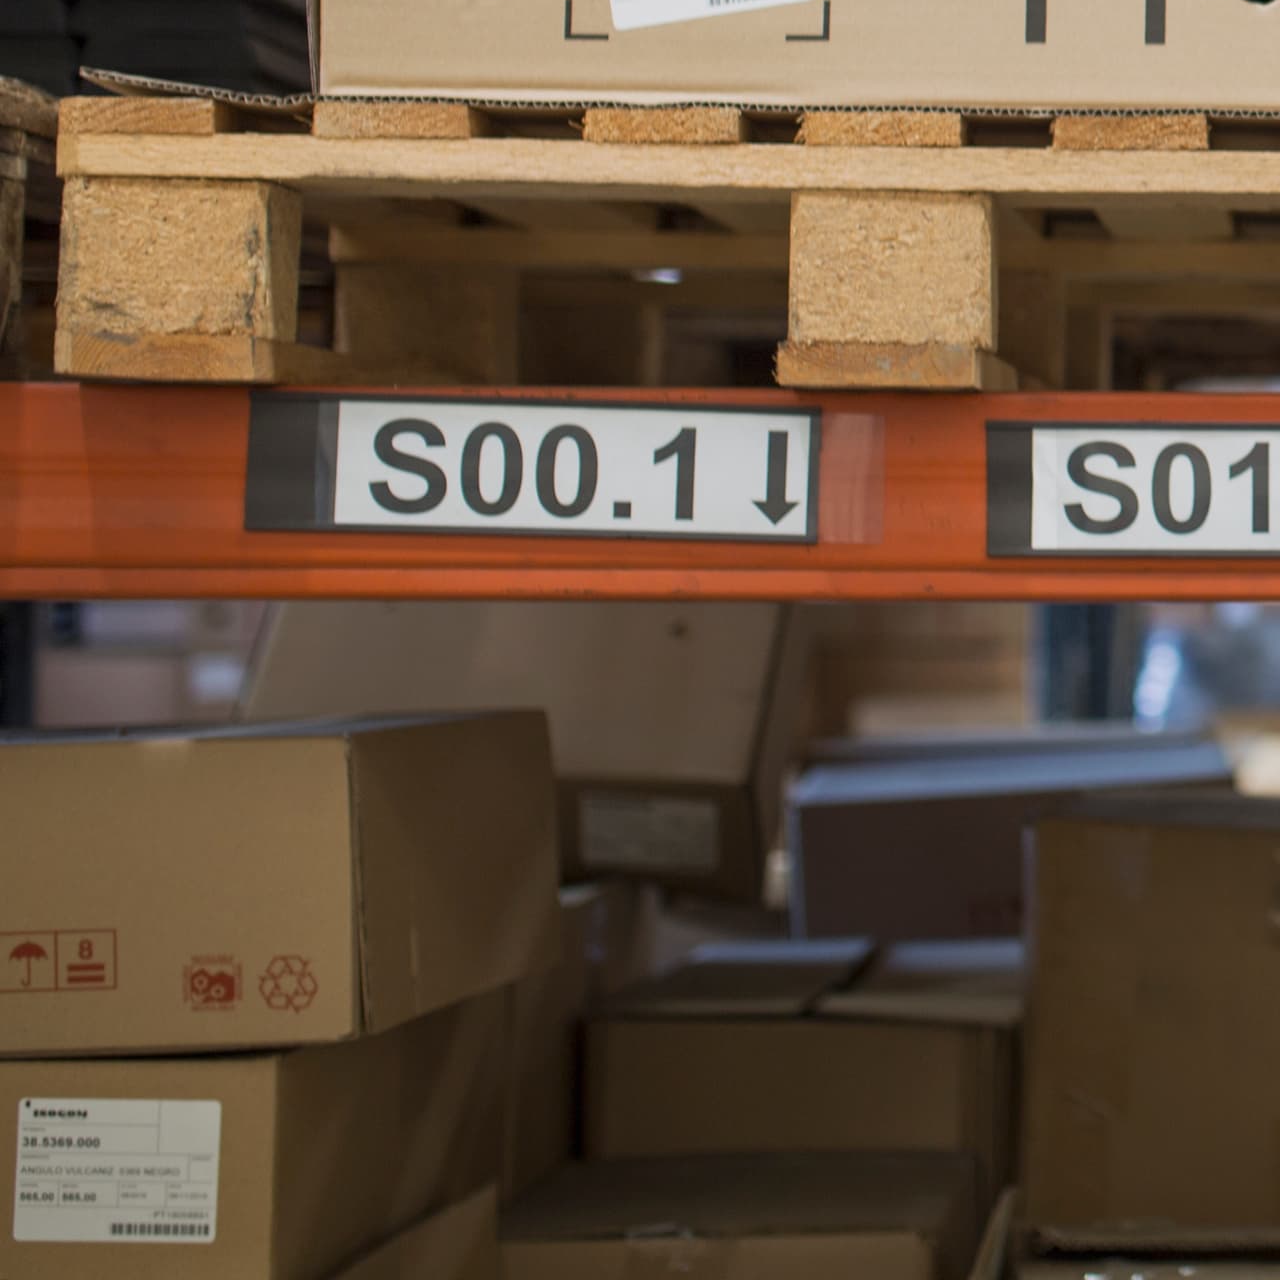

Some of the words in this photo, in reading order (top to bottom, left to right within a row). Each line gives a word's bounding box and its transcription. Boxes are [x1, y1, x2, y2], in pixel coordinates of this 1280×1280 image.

[369, 417, 696, 520] S00.1
[78, 939, 93, 960] 8
[143, 1167, 181, 1177] NEGRO
